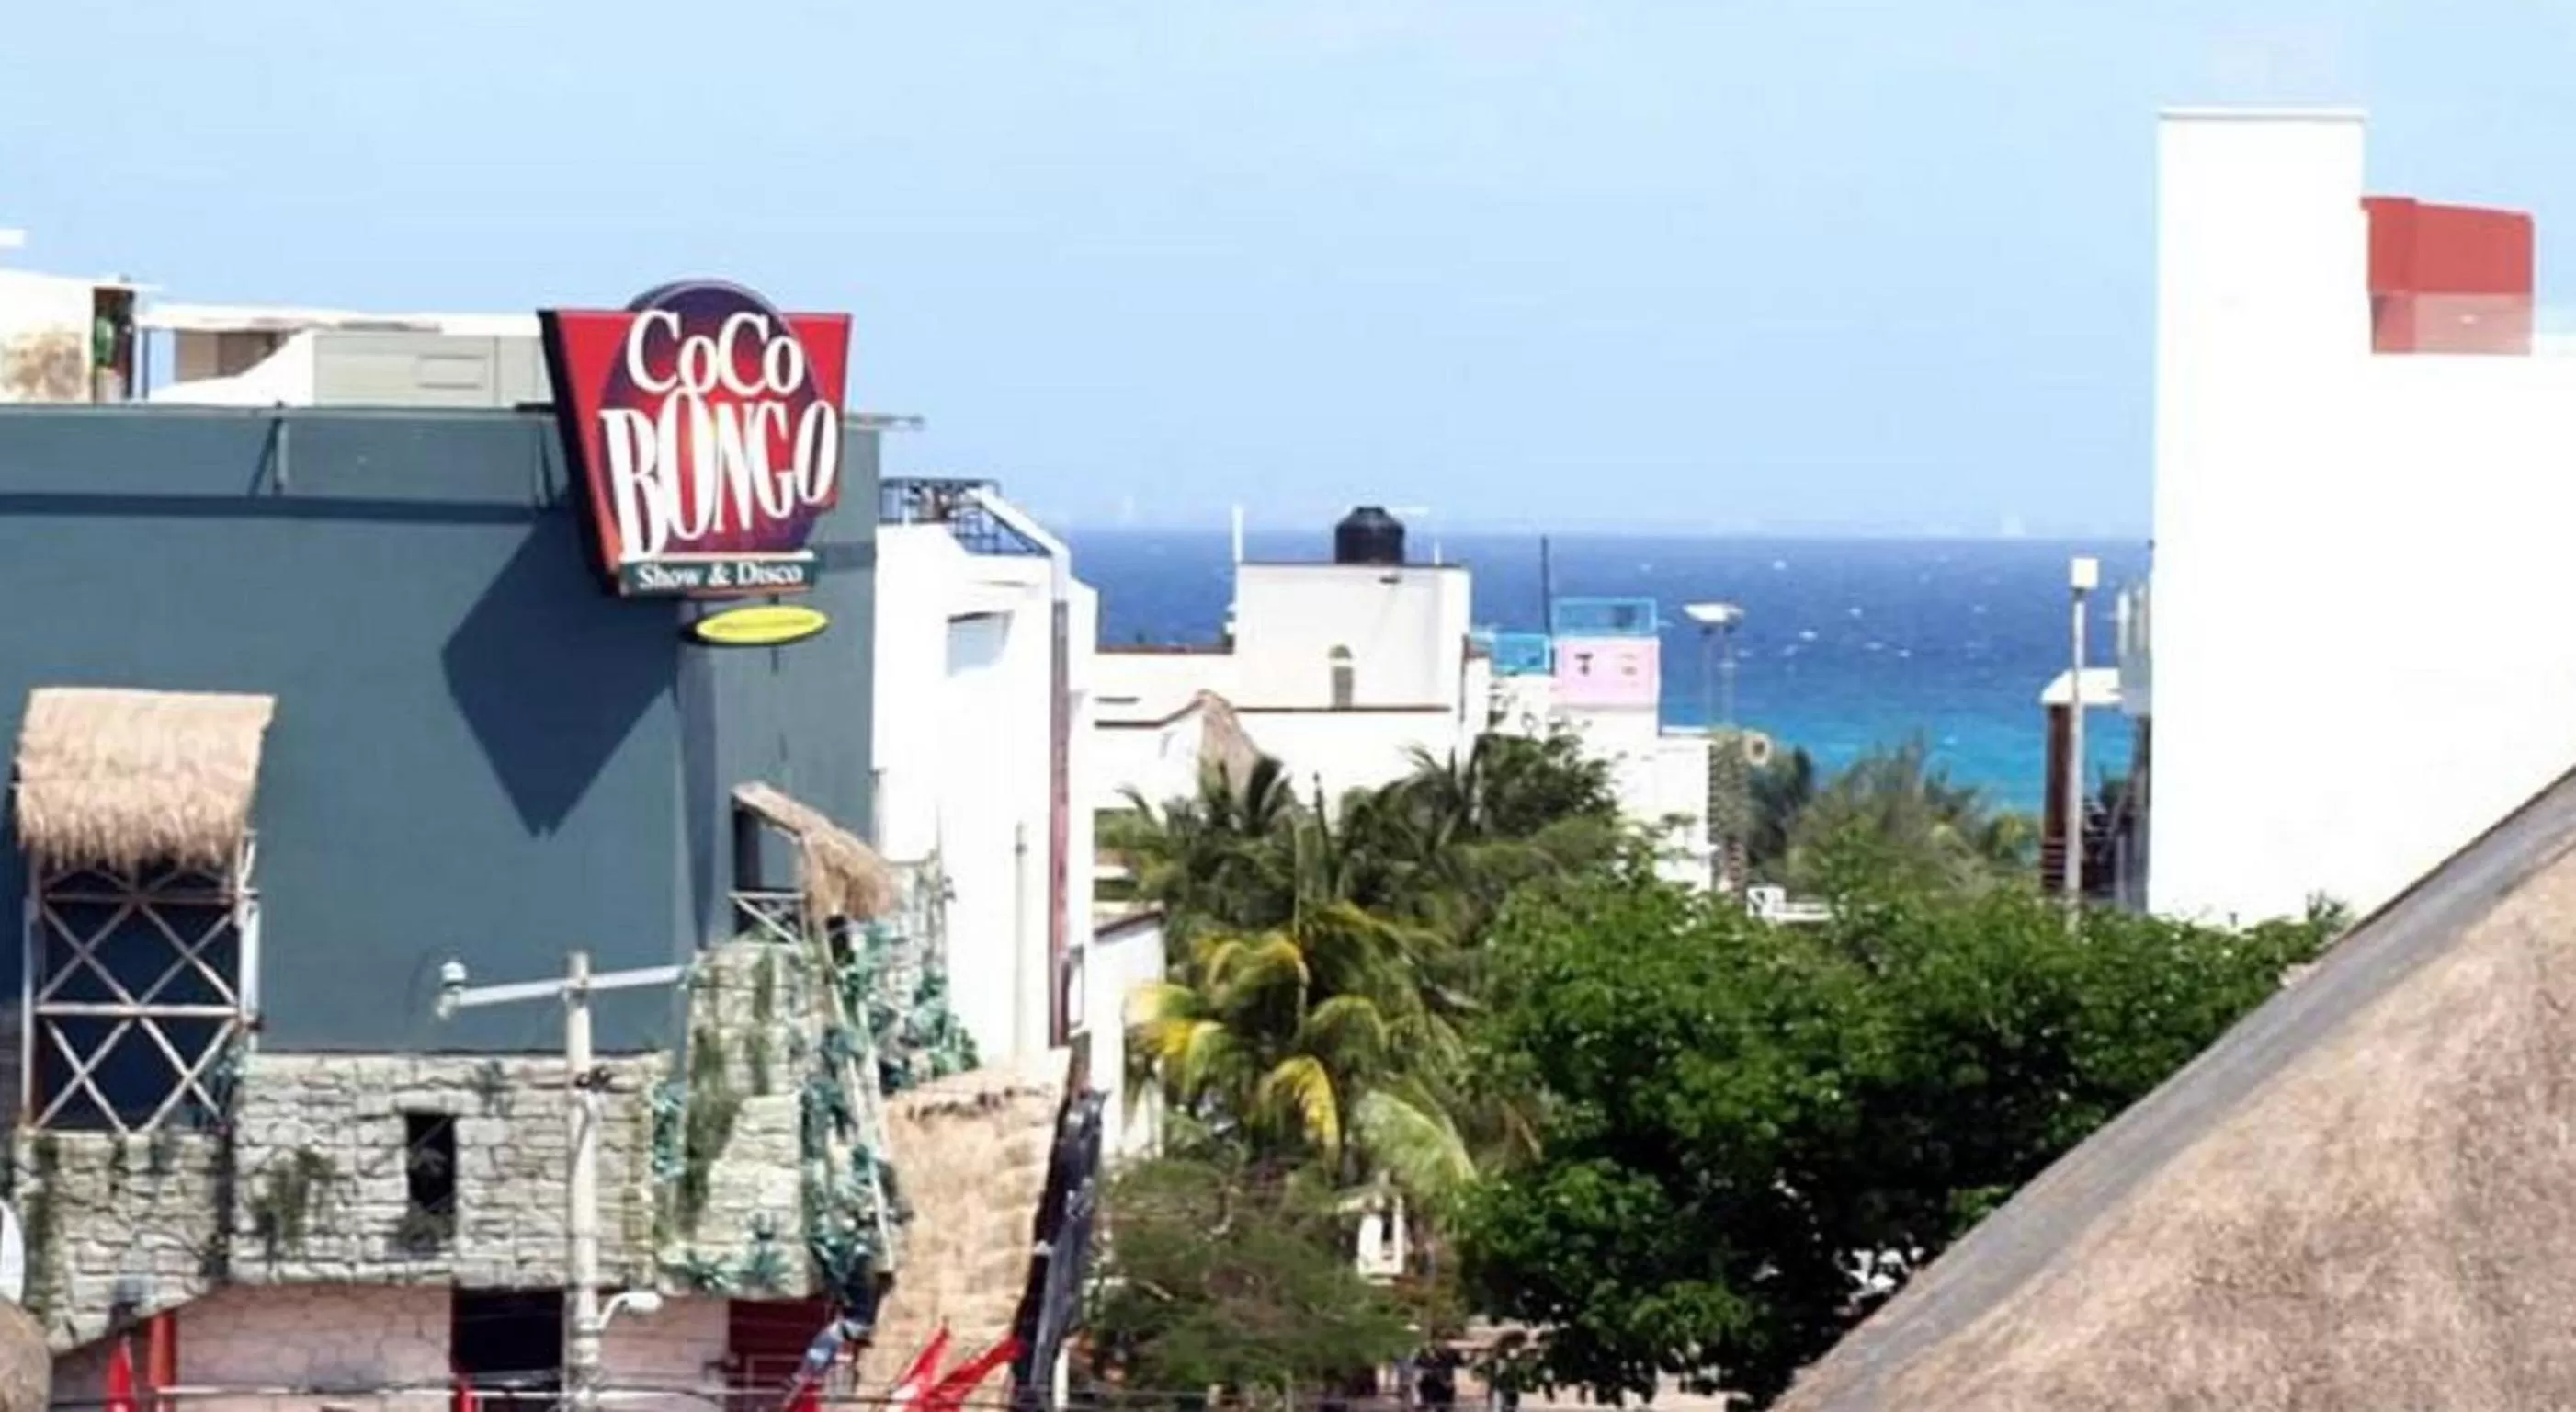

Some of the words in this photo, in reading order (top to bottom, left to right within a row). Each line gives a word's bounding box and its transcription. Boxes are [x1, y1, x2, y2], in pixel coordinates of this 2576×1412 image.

[597, 387, 838, 555] BONGO
[638, 563, 701, 589] Show
[708, 563, 732, 588] &
[737, 561, 804, 586] Disco
